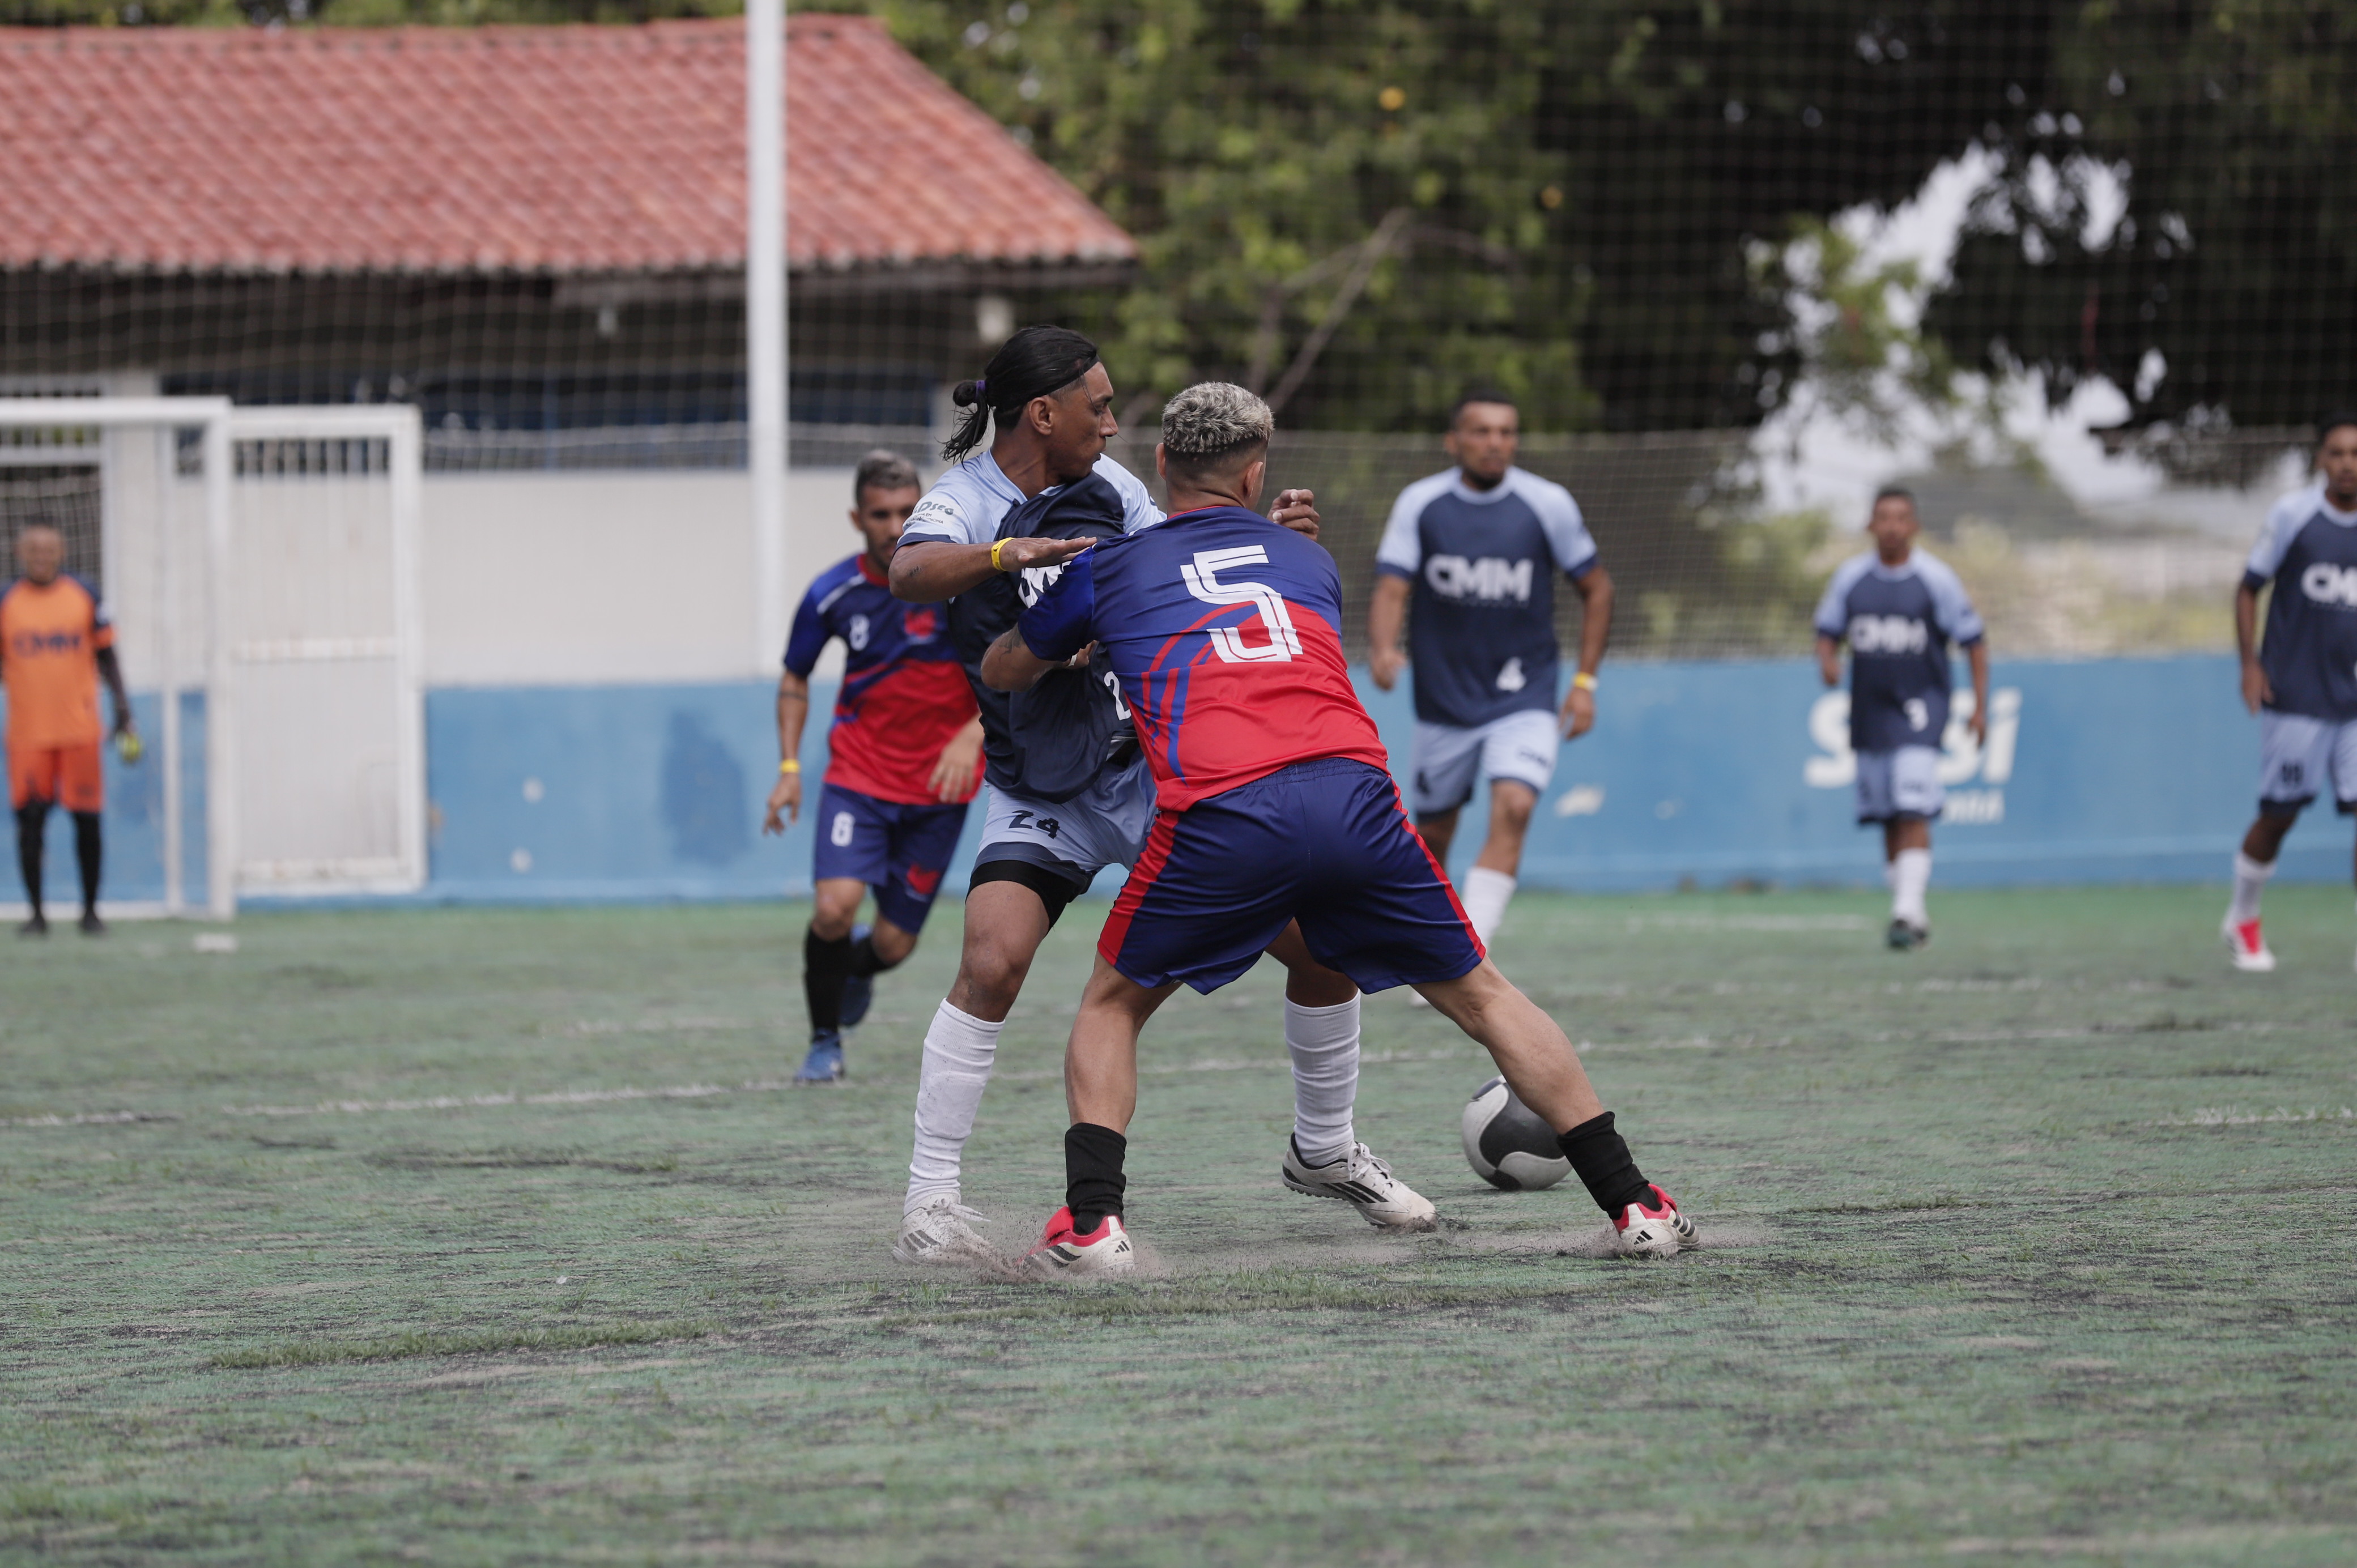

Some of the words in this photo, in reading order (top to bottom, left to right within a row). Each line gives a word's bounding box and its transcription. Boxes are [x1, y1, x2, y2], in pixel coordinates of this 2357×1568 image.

[1424, 553, 1534, 602] CMM
[1180, 544, 1303, 663] 5
[1495, 657, 1527, 692] 4
[1009, 809, 1060, 840] 24
